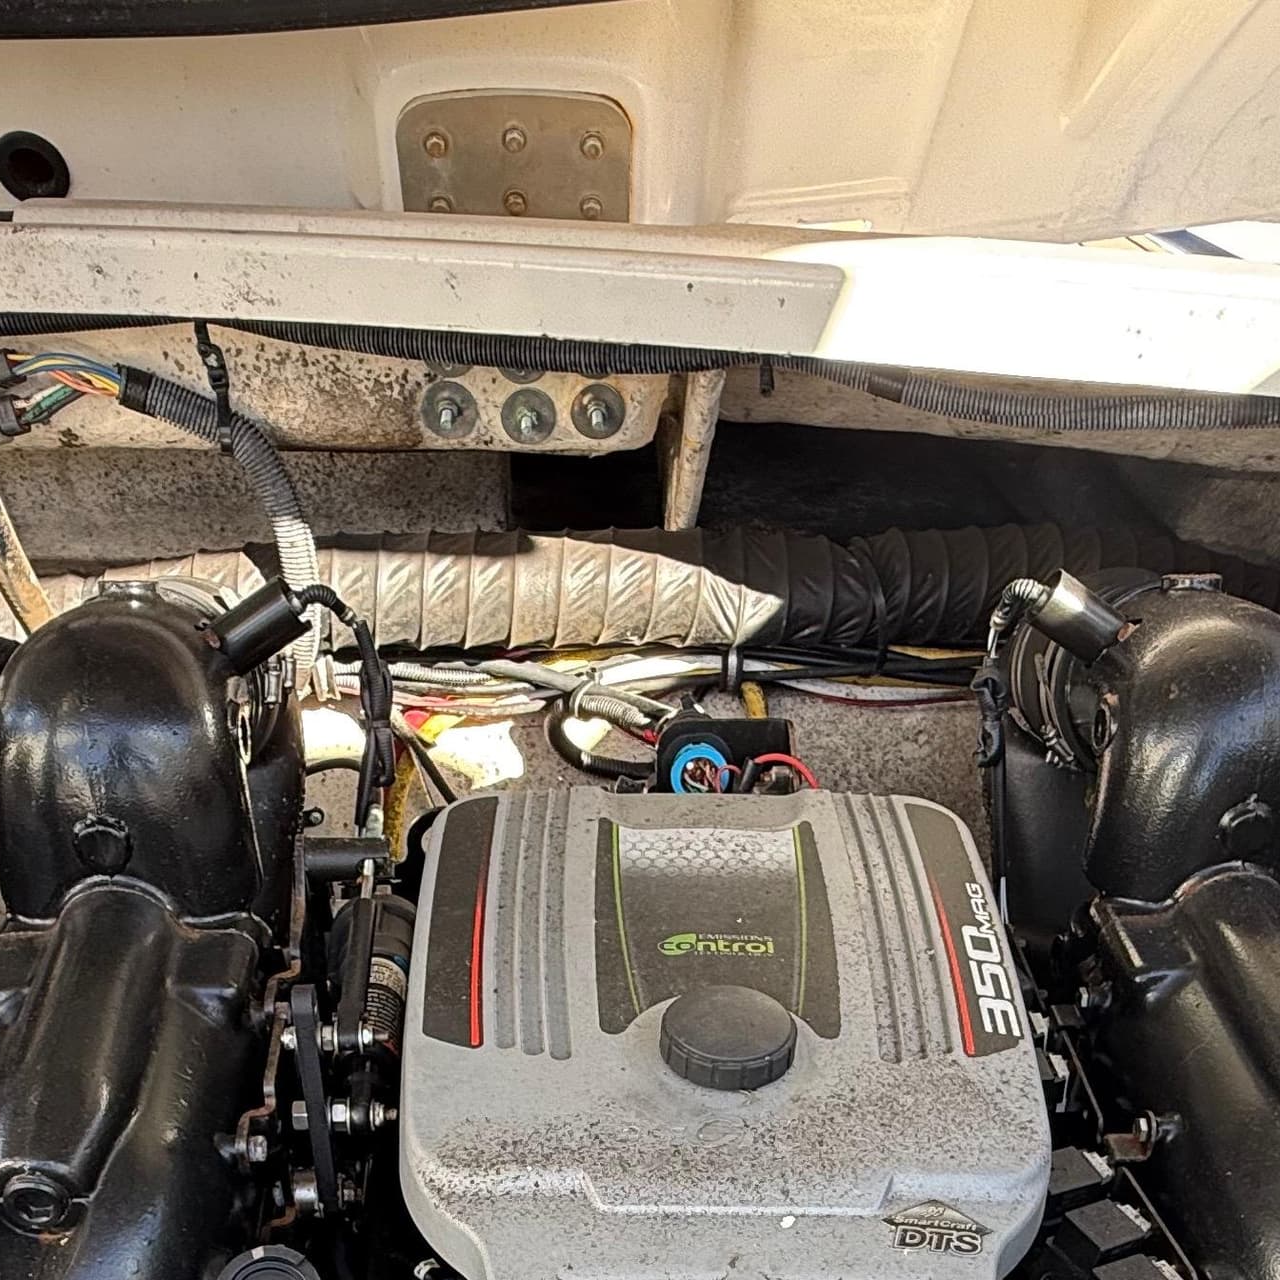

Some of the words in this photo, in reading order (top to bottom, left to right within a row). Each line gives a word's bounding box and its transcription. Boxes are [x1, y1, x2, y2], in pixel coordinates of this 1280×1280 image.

[964, 882, 996, 934] MAG
[961, 924, 1022, 1037] 350
[893, 1215, 977, 1231] SmartCraft
[893, 1225, 982, 1255] DTS
